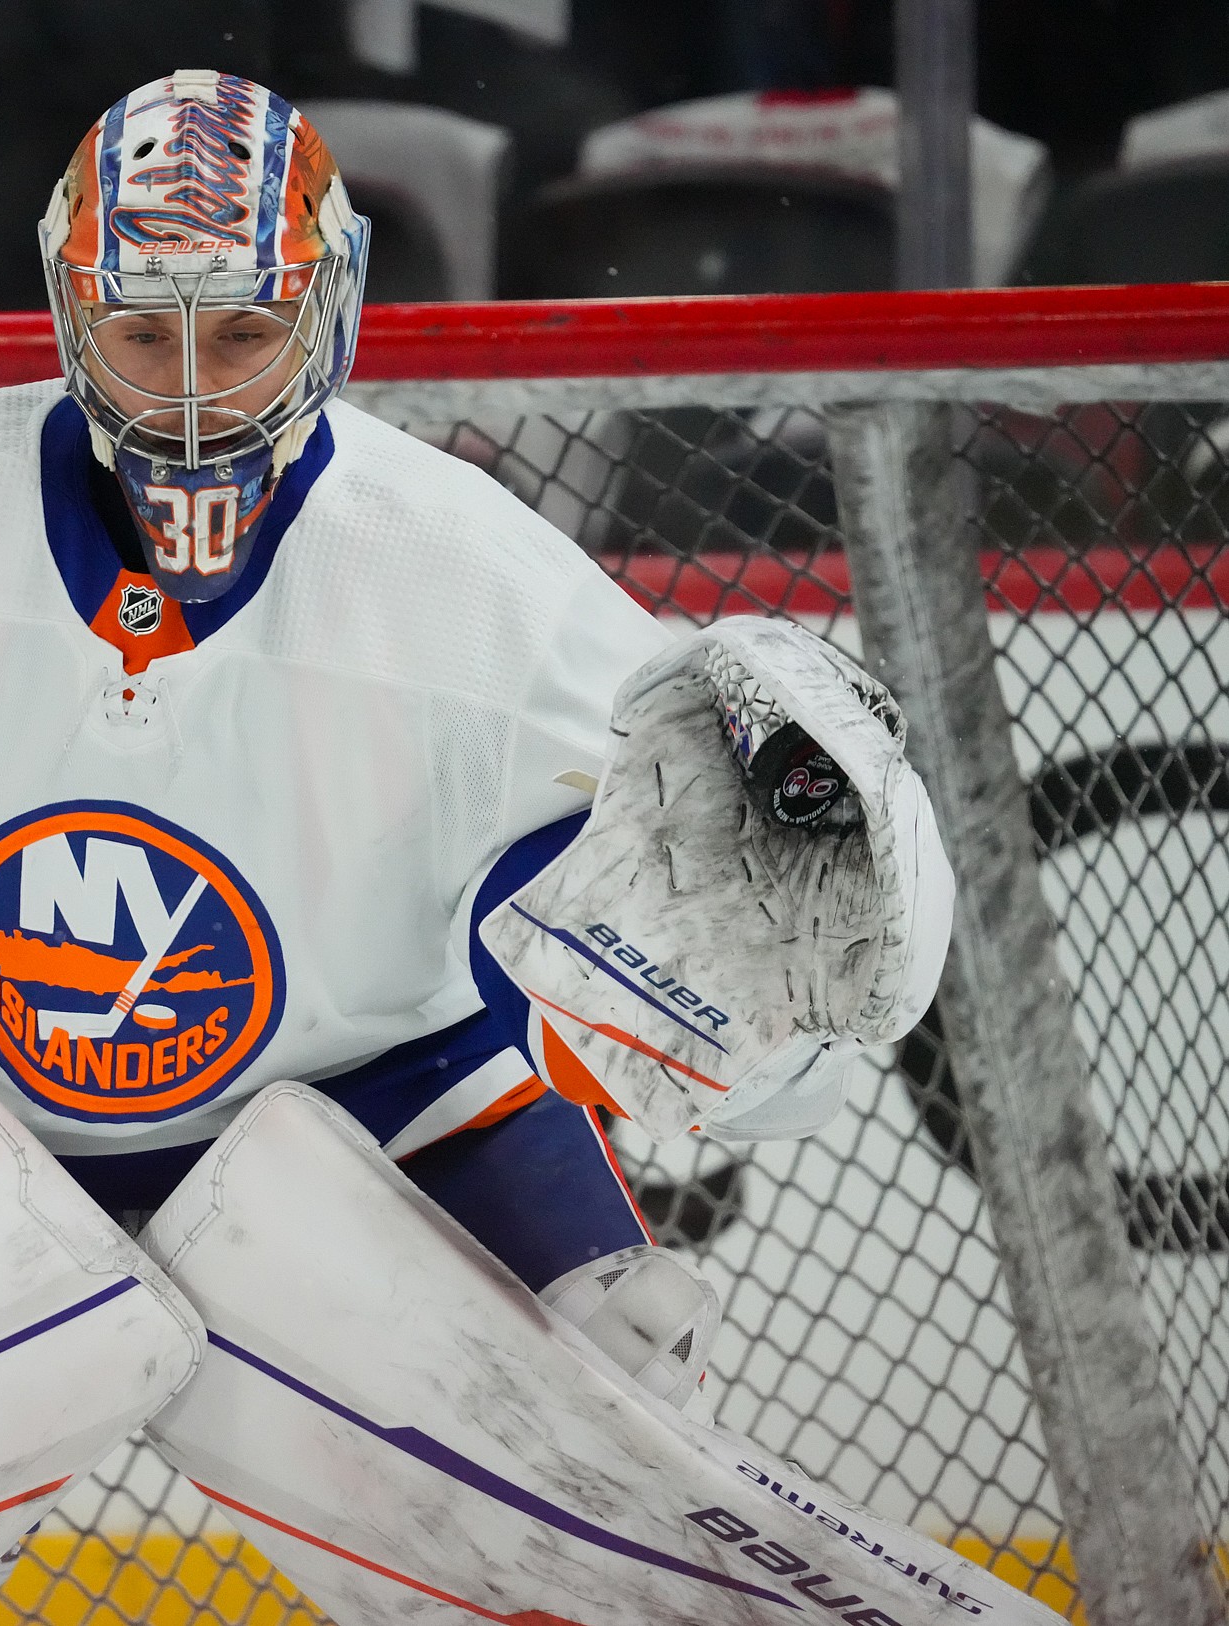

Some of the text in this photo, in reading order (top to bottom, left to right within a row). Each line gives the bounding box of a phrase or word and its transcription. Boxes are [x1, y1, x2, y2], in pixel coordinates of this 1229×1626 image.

[144, 483, 242, 577] 30
[127, 599, 156, 623] NHL
[773, 787, 782, 809] YORK
[775, 808, 790, 822] NEW
[796, 799, 831, 824] CAROLINA
[20, 832, 209, 994] NY
